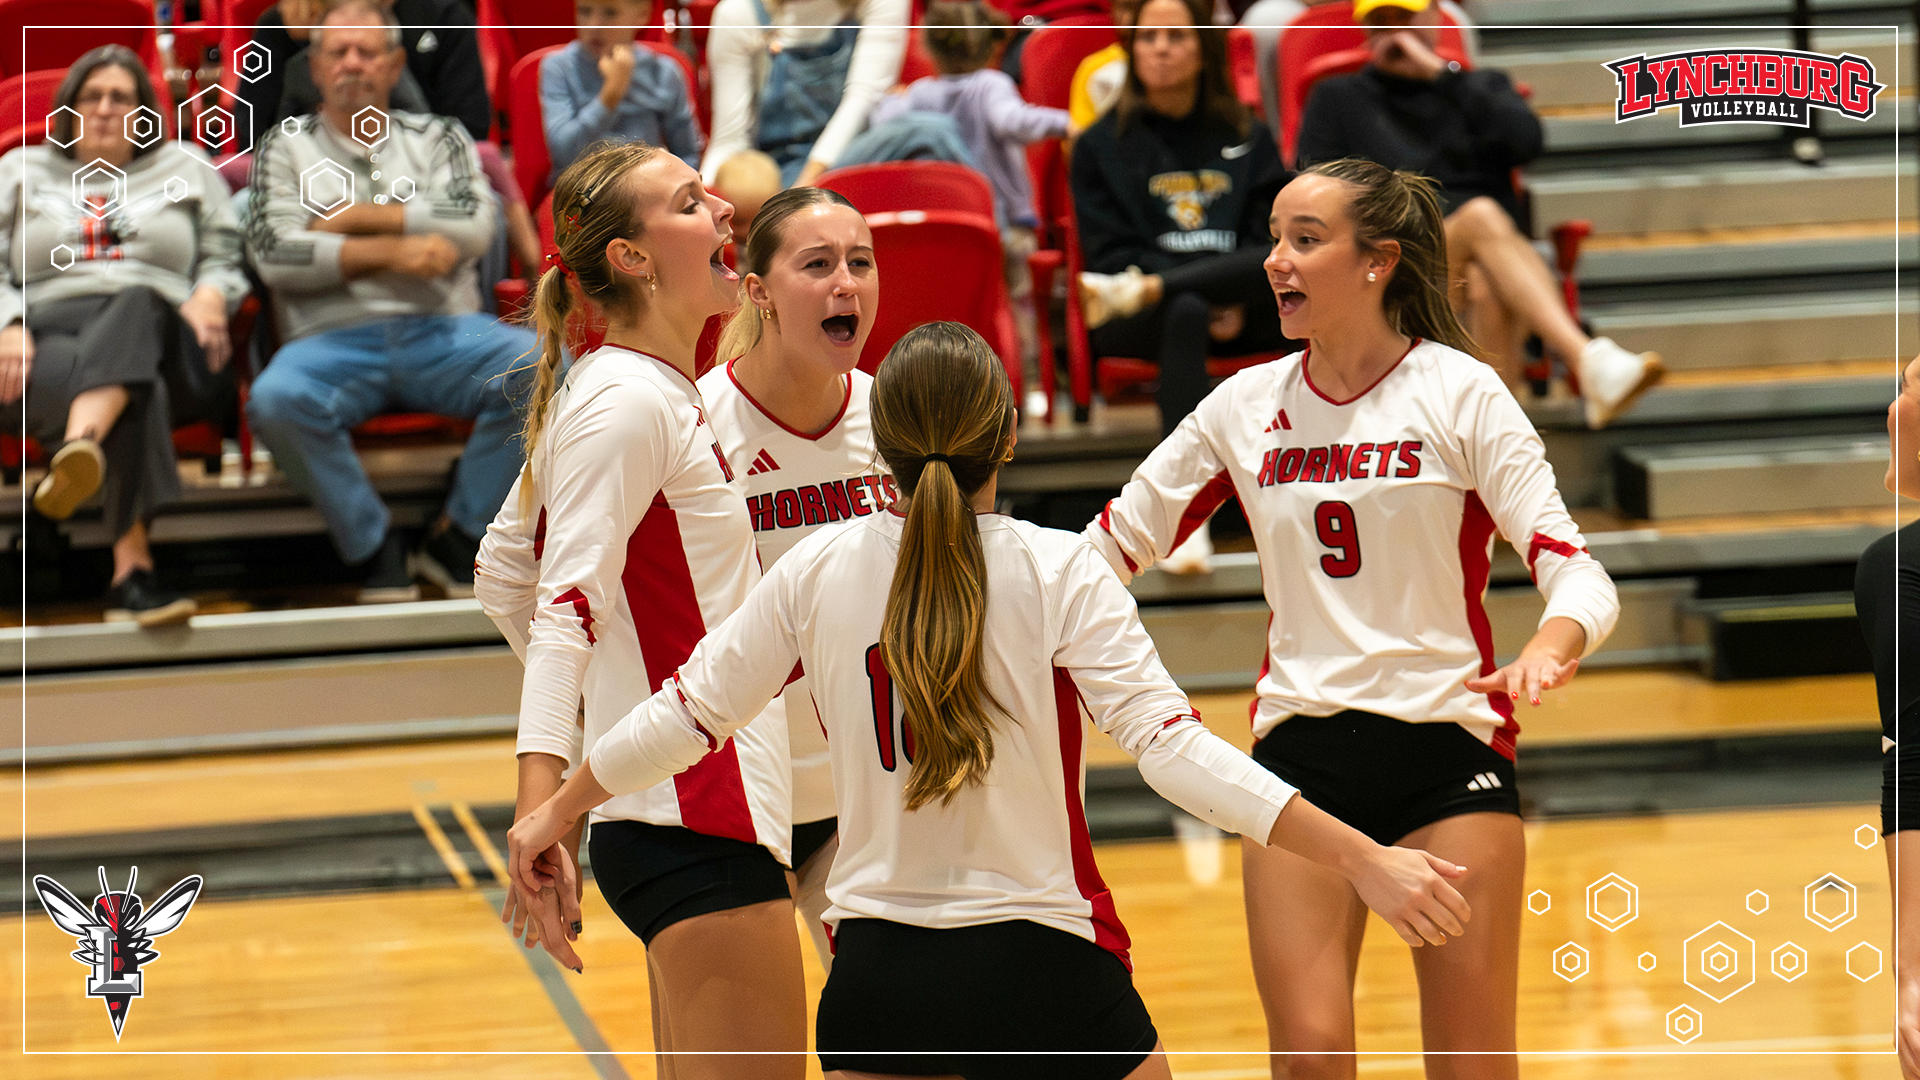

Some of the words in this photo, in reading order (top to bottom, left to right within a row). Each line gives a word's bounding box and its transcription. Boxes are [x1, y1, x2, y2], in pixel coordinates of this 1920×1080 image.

[1257, 440, 1423, 488] HORNETS
[1314, 500, 1362, 579] 9
[865, 642, 916, 773] 1
